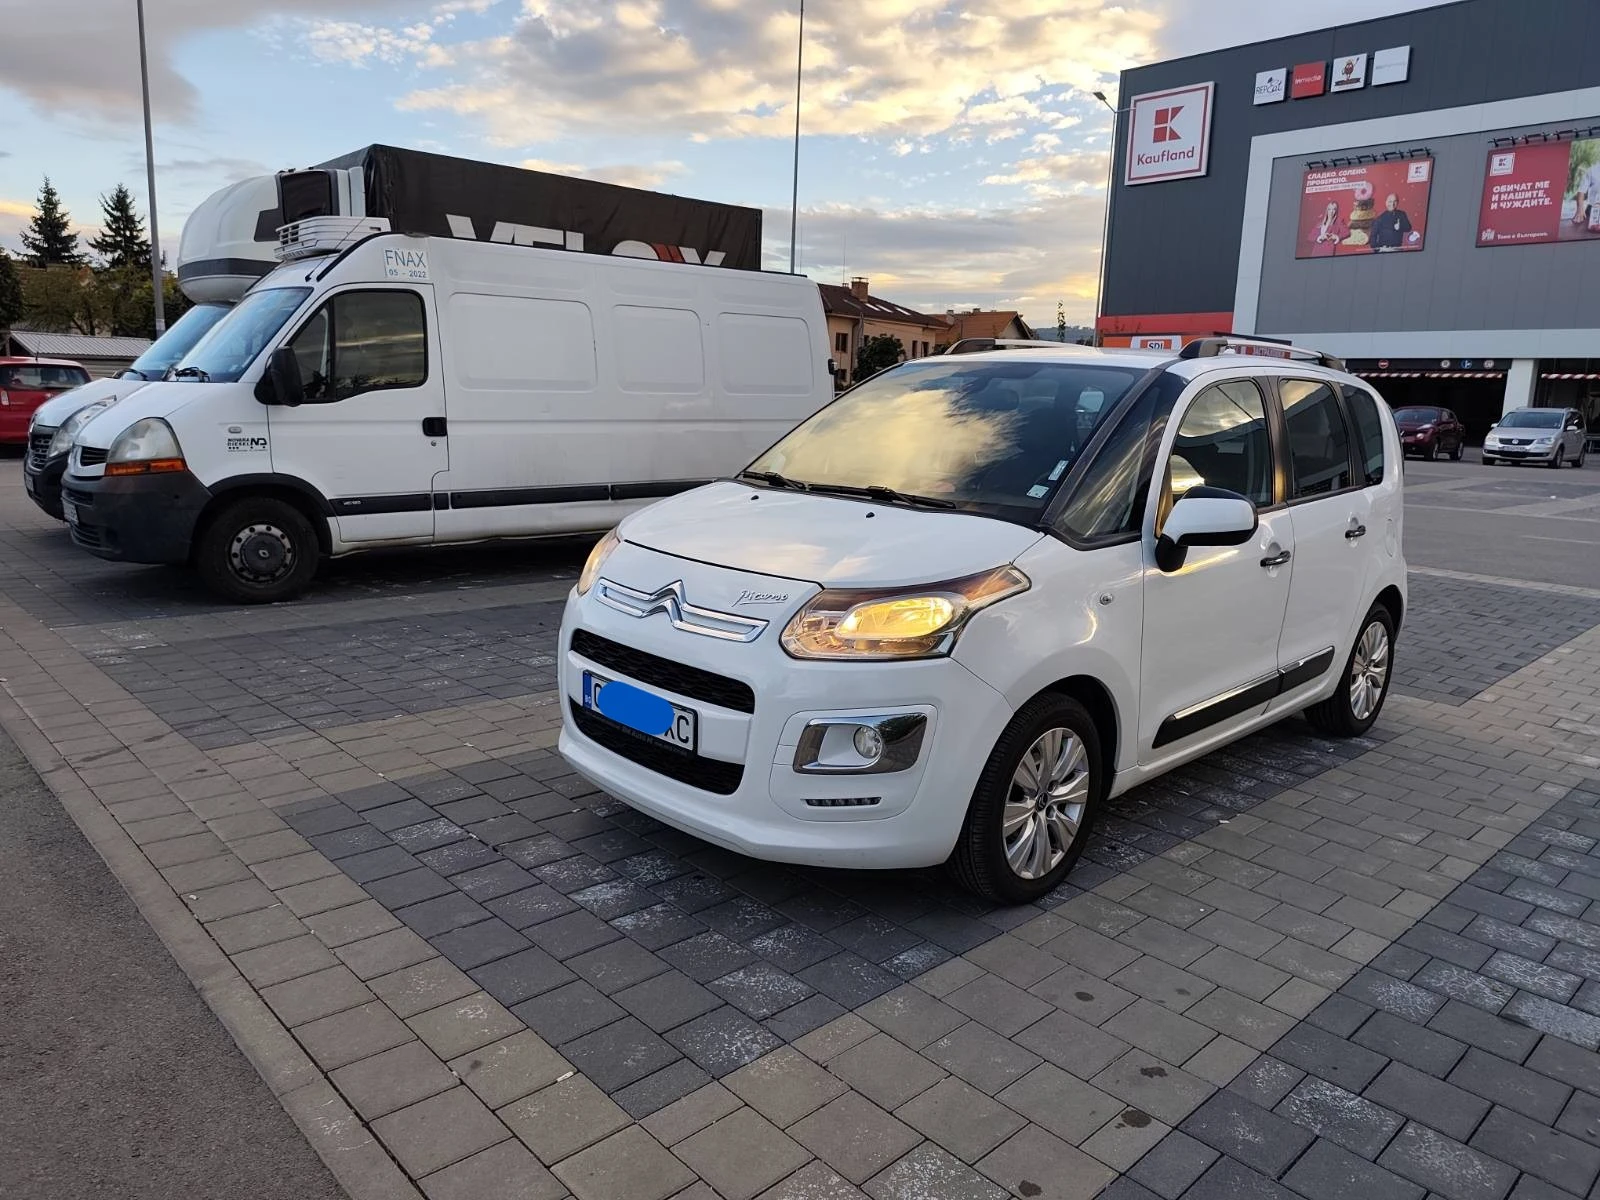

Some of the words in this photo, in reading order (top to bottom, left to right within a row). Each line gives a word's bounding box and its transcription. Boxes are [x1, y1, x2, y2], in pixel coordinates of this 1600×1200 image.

[1137, 146, 1195, 166] Kaufland
[1493, 182, 1533, 193] ОБИЧАТ
[1535, 180, 1550, 189] МЕ
[1491, 194, 1499, 202] И
[1500, 189, 1546, 201] НАШИТЕ,
[1490, 202, 1498, 210] И
[1500, 197, 1553, 209] ЧУЖДИТЕ.
[385, 249, 426, 268] FNAX
[408, 270, 427, 278] 2022
